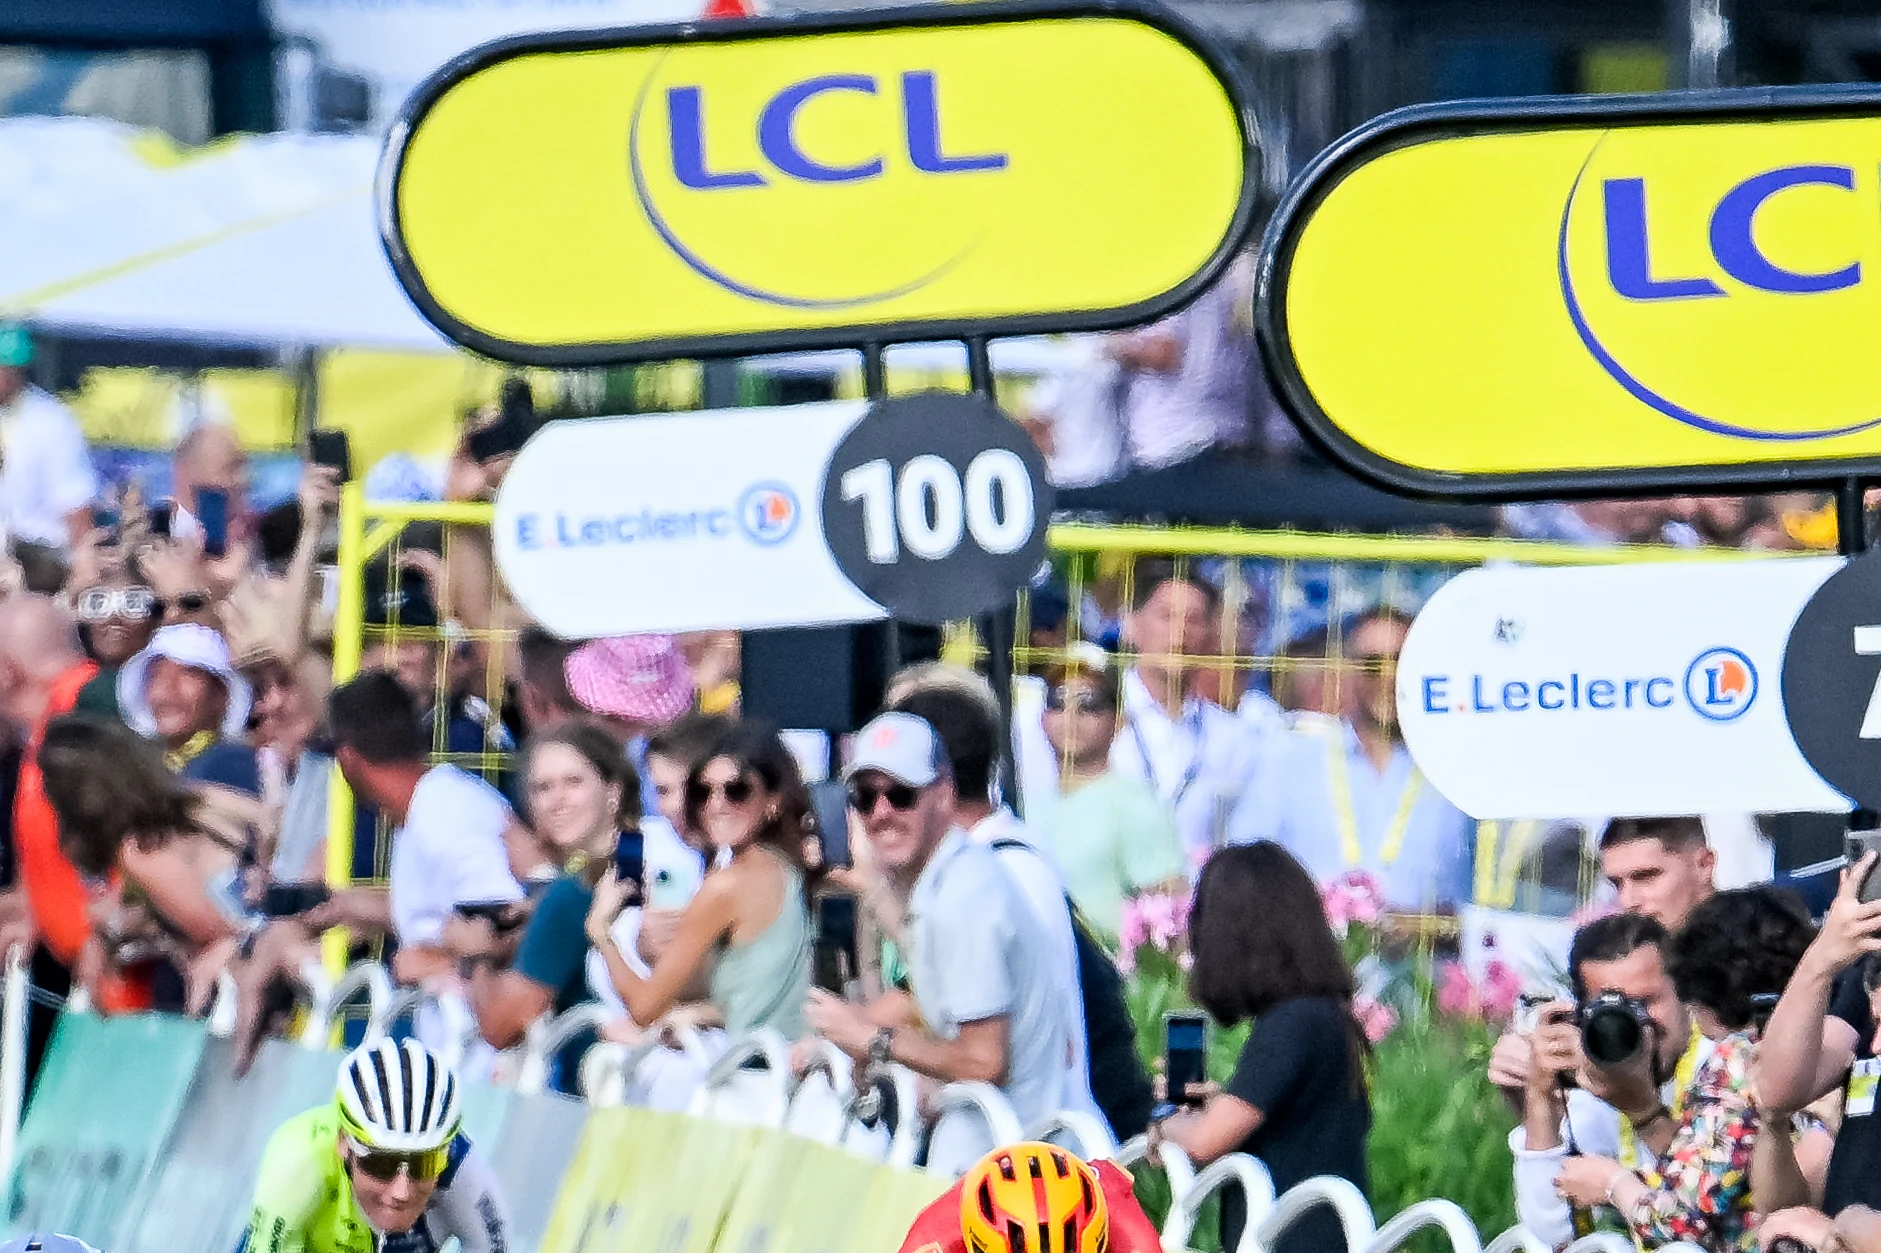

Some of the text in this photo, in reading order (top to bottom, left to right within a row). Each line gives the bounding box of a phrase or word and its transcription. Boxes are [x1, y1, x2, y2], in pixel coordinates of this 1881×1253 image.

[664, 69, 1009, 191] LCL
[839, 447, 1035, 564] 100
[1421, 667, 1676, 717] E.Leclerc
